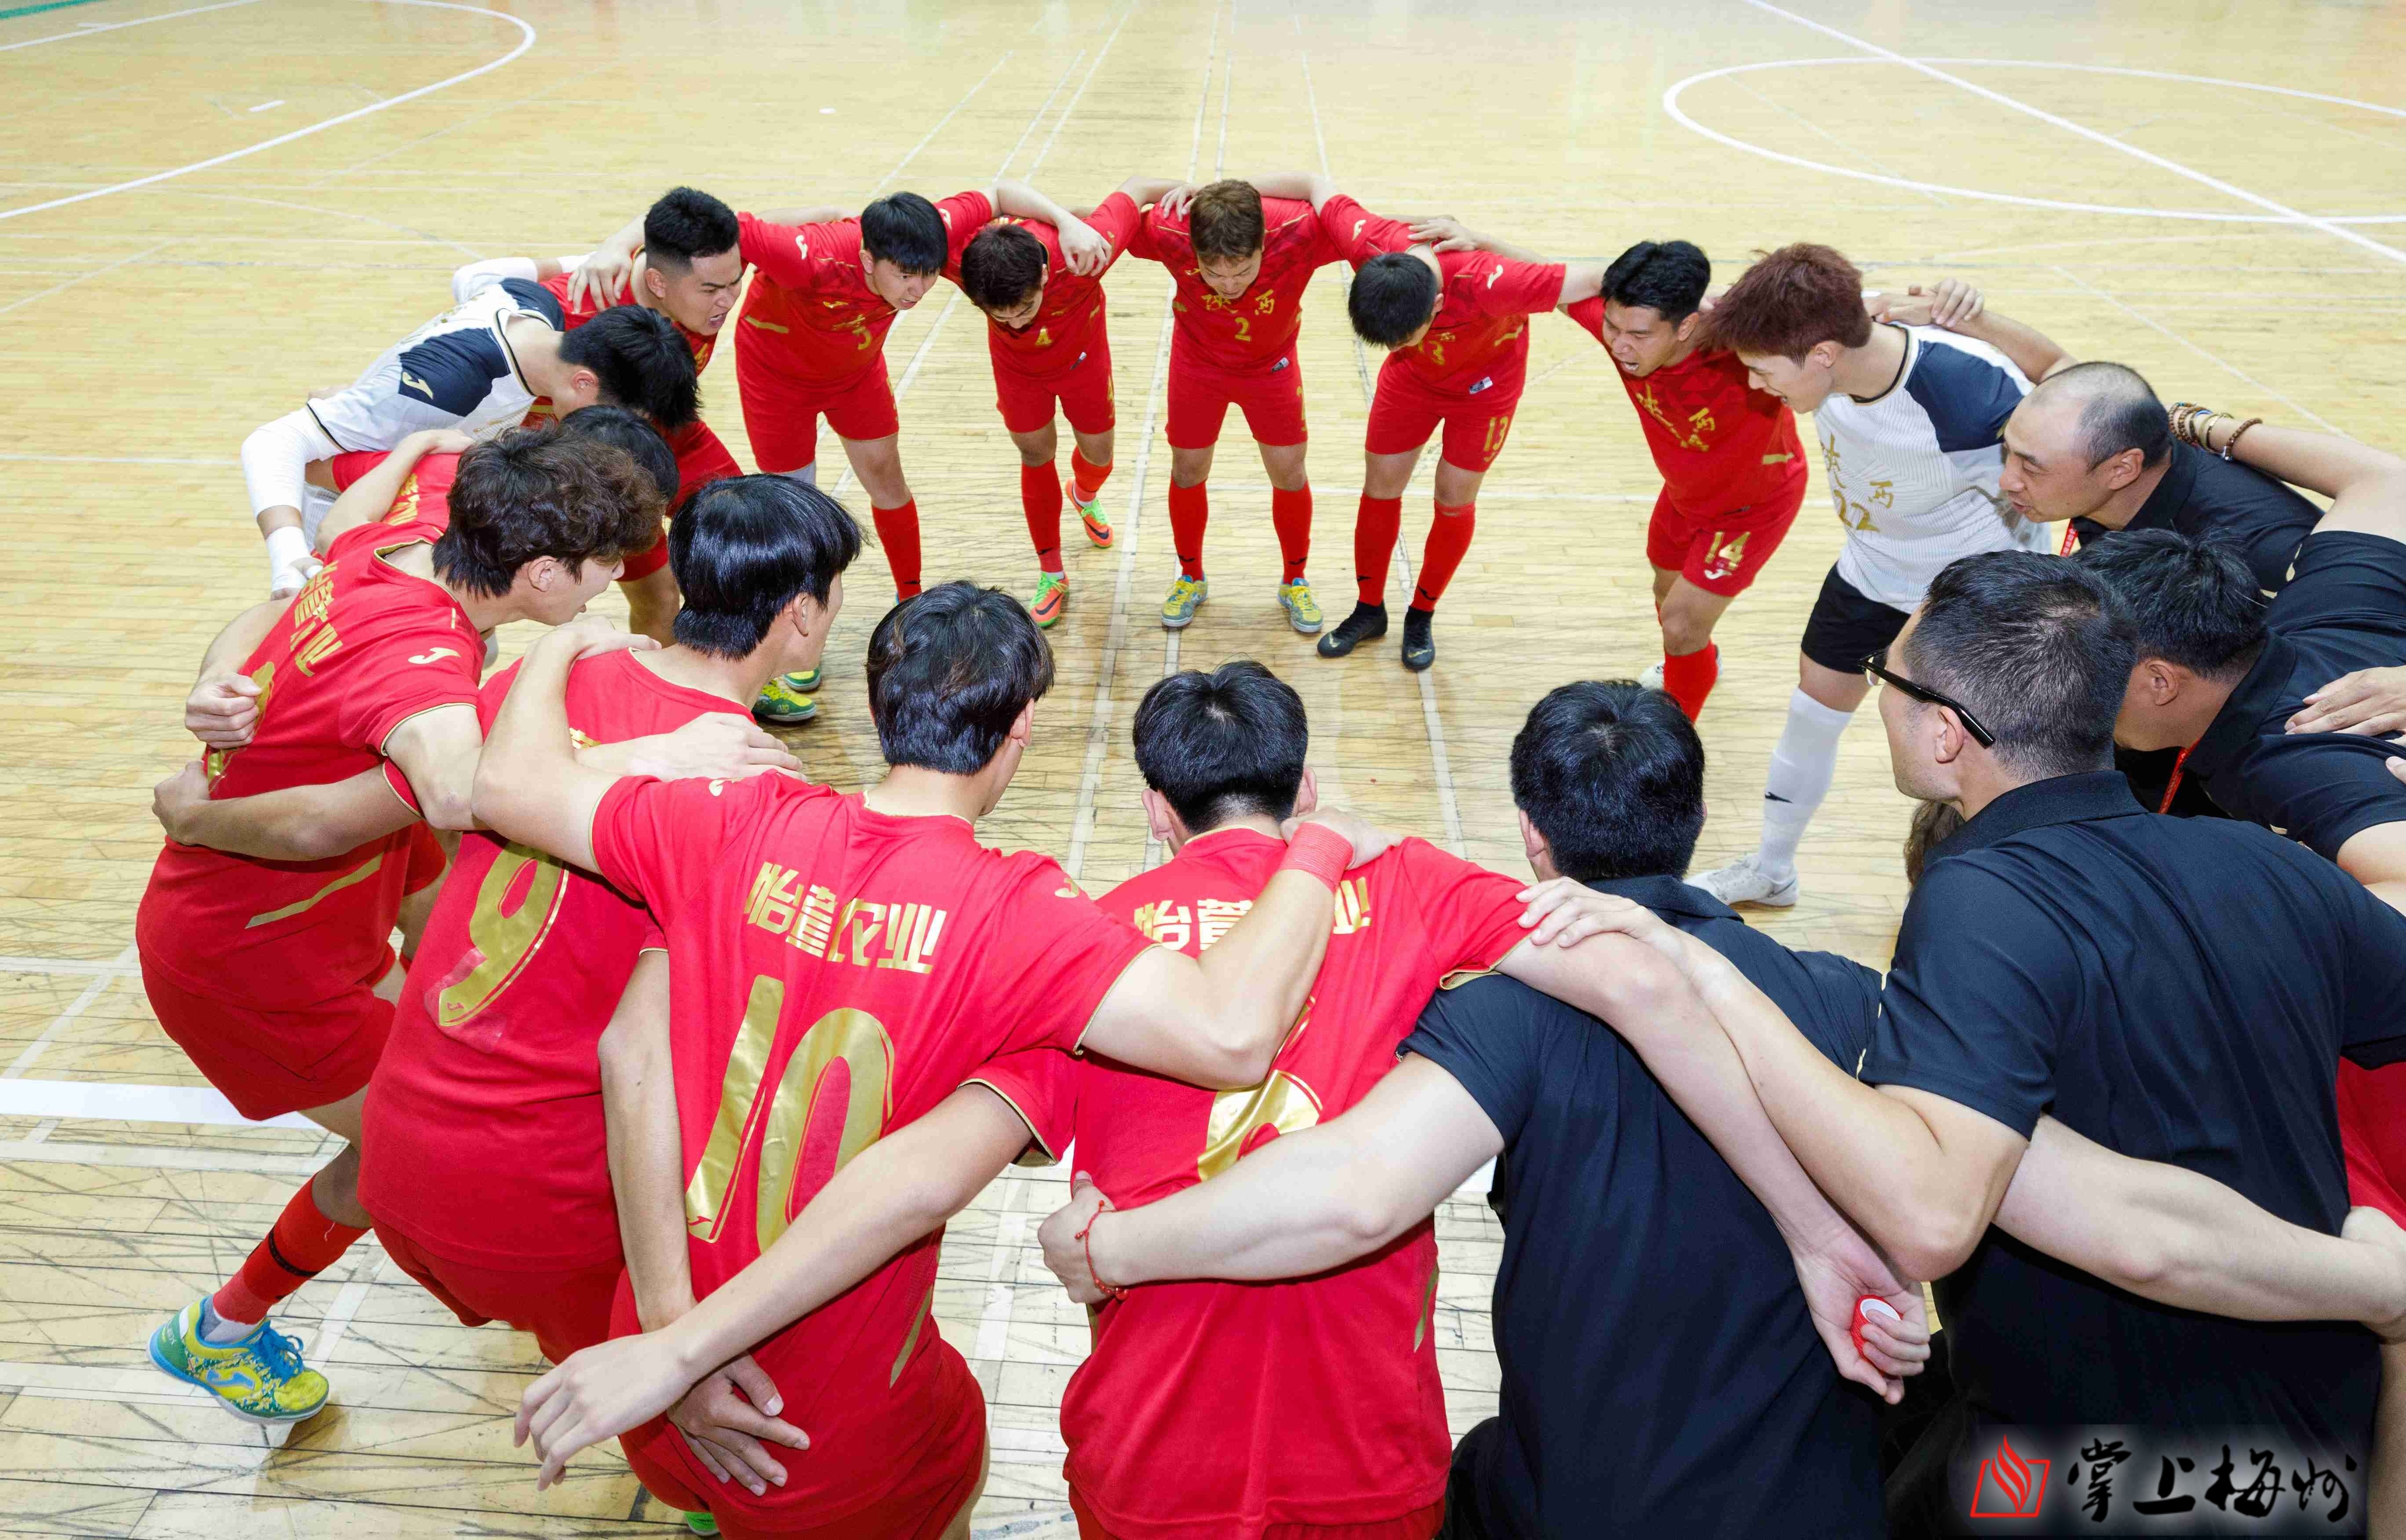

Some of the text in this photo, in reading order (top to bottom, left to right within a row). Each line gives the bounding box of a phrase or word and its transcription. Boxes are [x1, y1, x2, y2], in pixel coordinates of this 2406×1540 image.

[1234, 317, 1251, 342] 2
[1484, 416, 1508, 451] 13
[1834, 489, 1880, 533] 22
[1704, 531, 1750, 570] 14
[744, 861, 948, 973] 怡萱农业
[1134, 876, 1372, 951] 怡萱业
[685, 974, 894, 1254] 10
